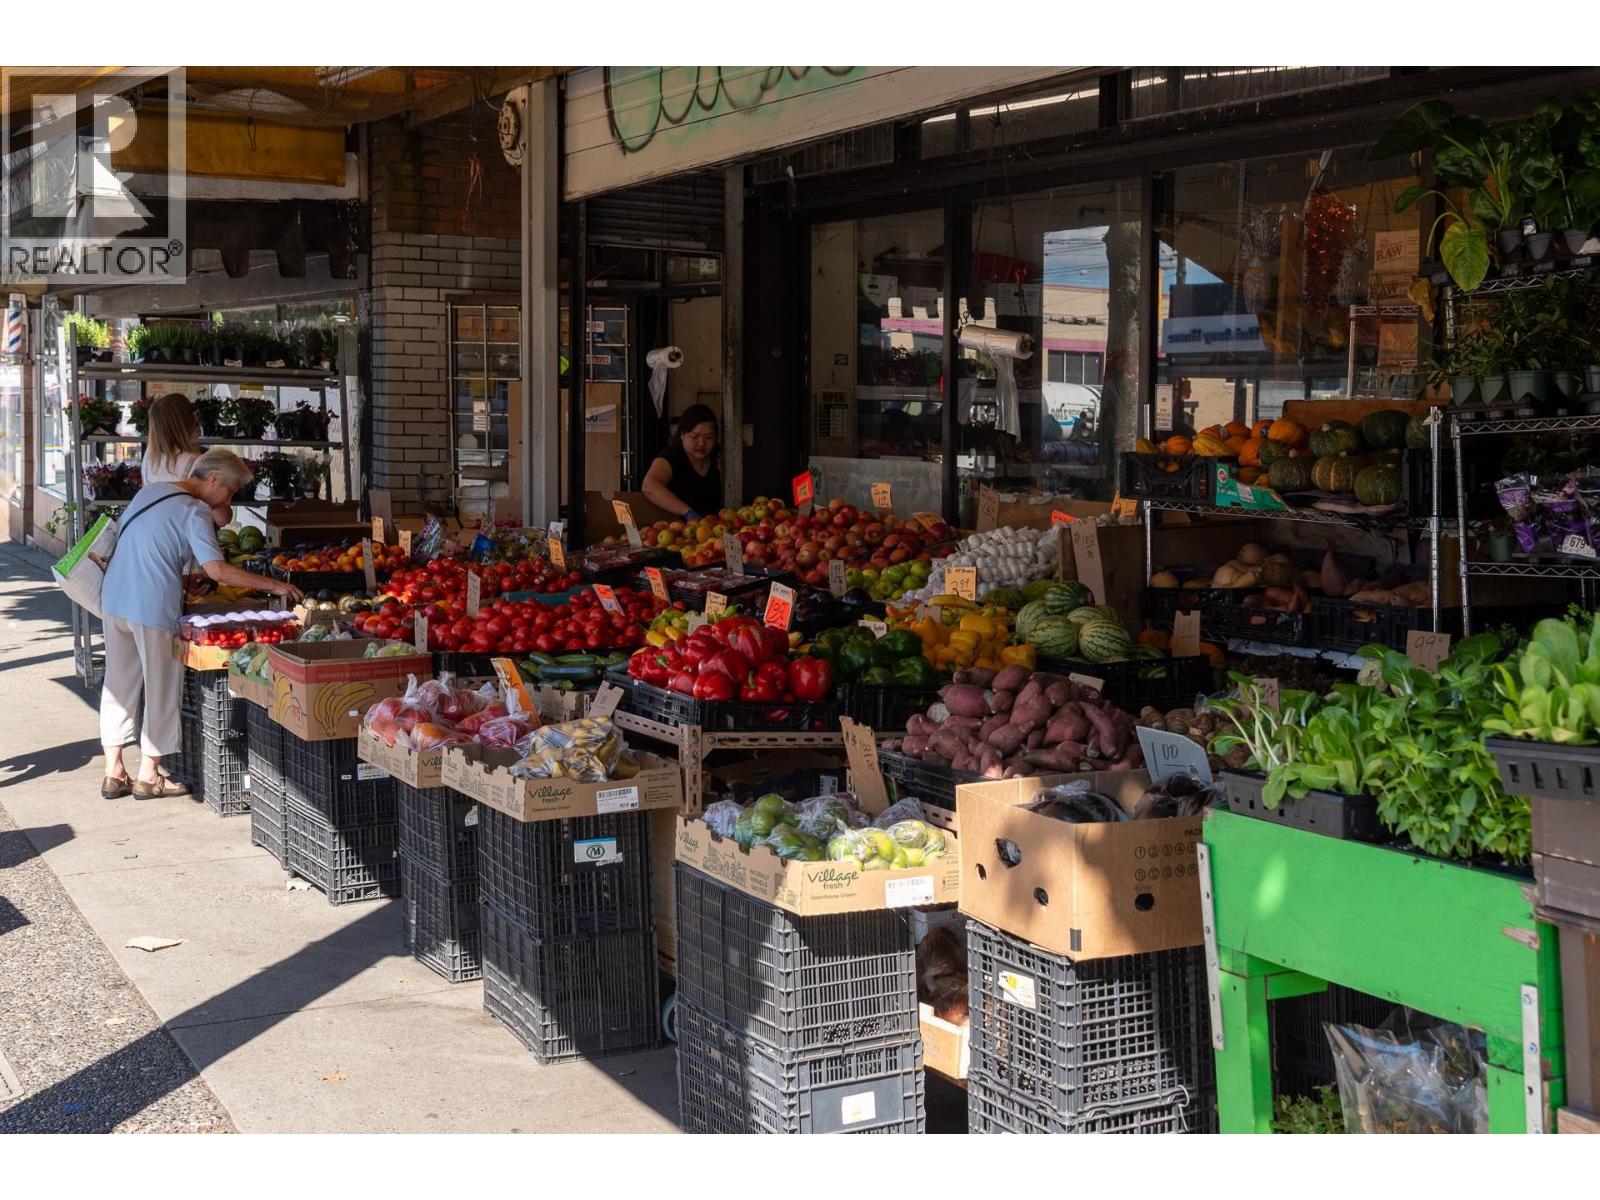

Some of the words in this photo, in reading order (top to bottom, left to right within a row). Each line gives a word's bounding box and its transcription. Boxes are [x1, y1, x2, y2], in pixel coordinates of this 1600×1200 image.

[1376, 243, 1403, 262] RAW
[528, 785, 574, 803] Village
[808, 868, 859, 887] Village
[823, 881, 843, 890] fresh
